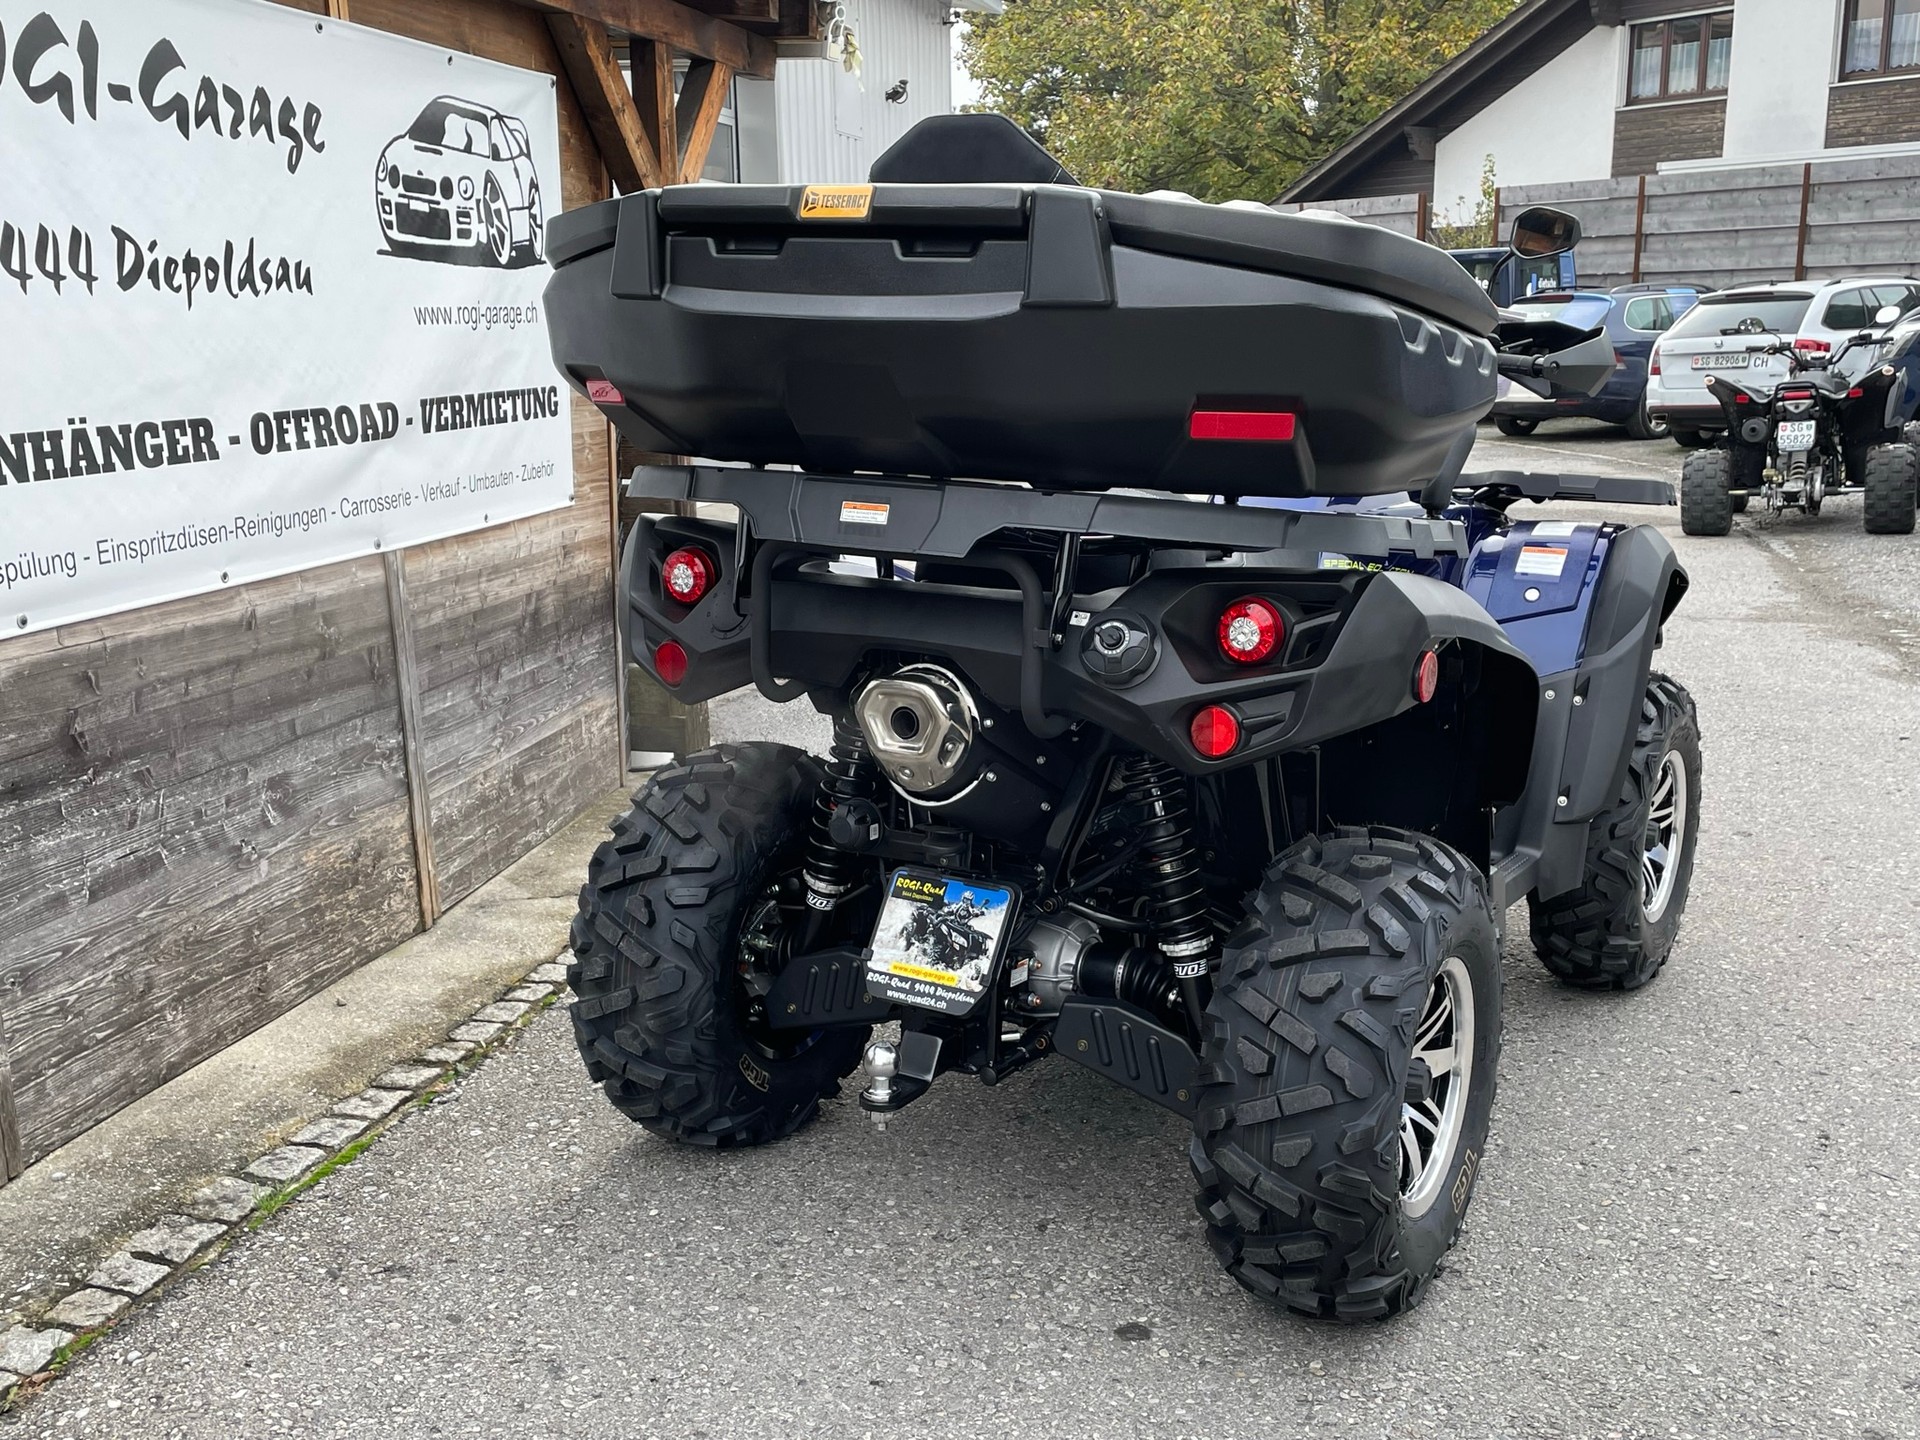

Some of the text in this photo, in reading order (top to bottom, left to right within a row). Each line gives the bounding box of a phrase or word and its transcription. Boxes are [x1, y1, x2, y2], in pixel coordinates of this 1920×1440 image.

[0, 11, 325, 174] GI-Garage
[820, 194, 868, 208] TESSERACT
[111, 224, 313, 311] Diepoldsau
[413, 302, 539, 330] www.rogi-garage.ch
[1714, 355, 1740, 366] 82906
[1753, 357, 1769, 368] CH
[250, 402, 399, 455] OFFROAD
[419, 385, 559, 434] VERMIETUNG
[1790, 423, 1803, 432] SG
[1780, 434, 1812, 445] 55822
[96, 507, 328, 566] Einspritzdüsen-Reinigungen
[340, 487, 412, 519] Carrosserie
[421, 478, 460, 503] Verkauf
[469, 470, 514, 493] Umbauten
[521, 459, 555, 483] Zubehör
[896, 877, 946, 896] ROGI-Quad
[866, 972, 911, 990] ROGI-Quad
[886, 989, 947, 1010] www.quad24.ch
